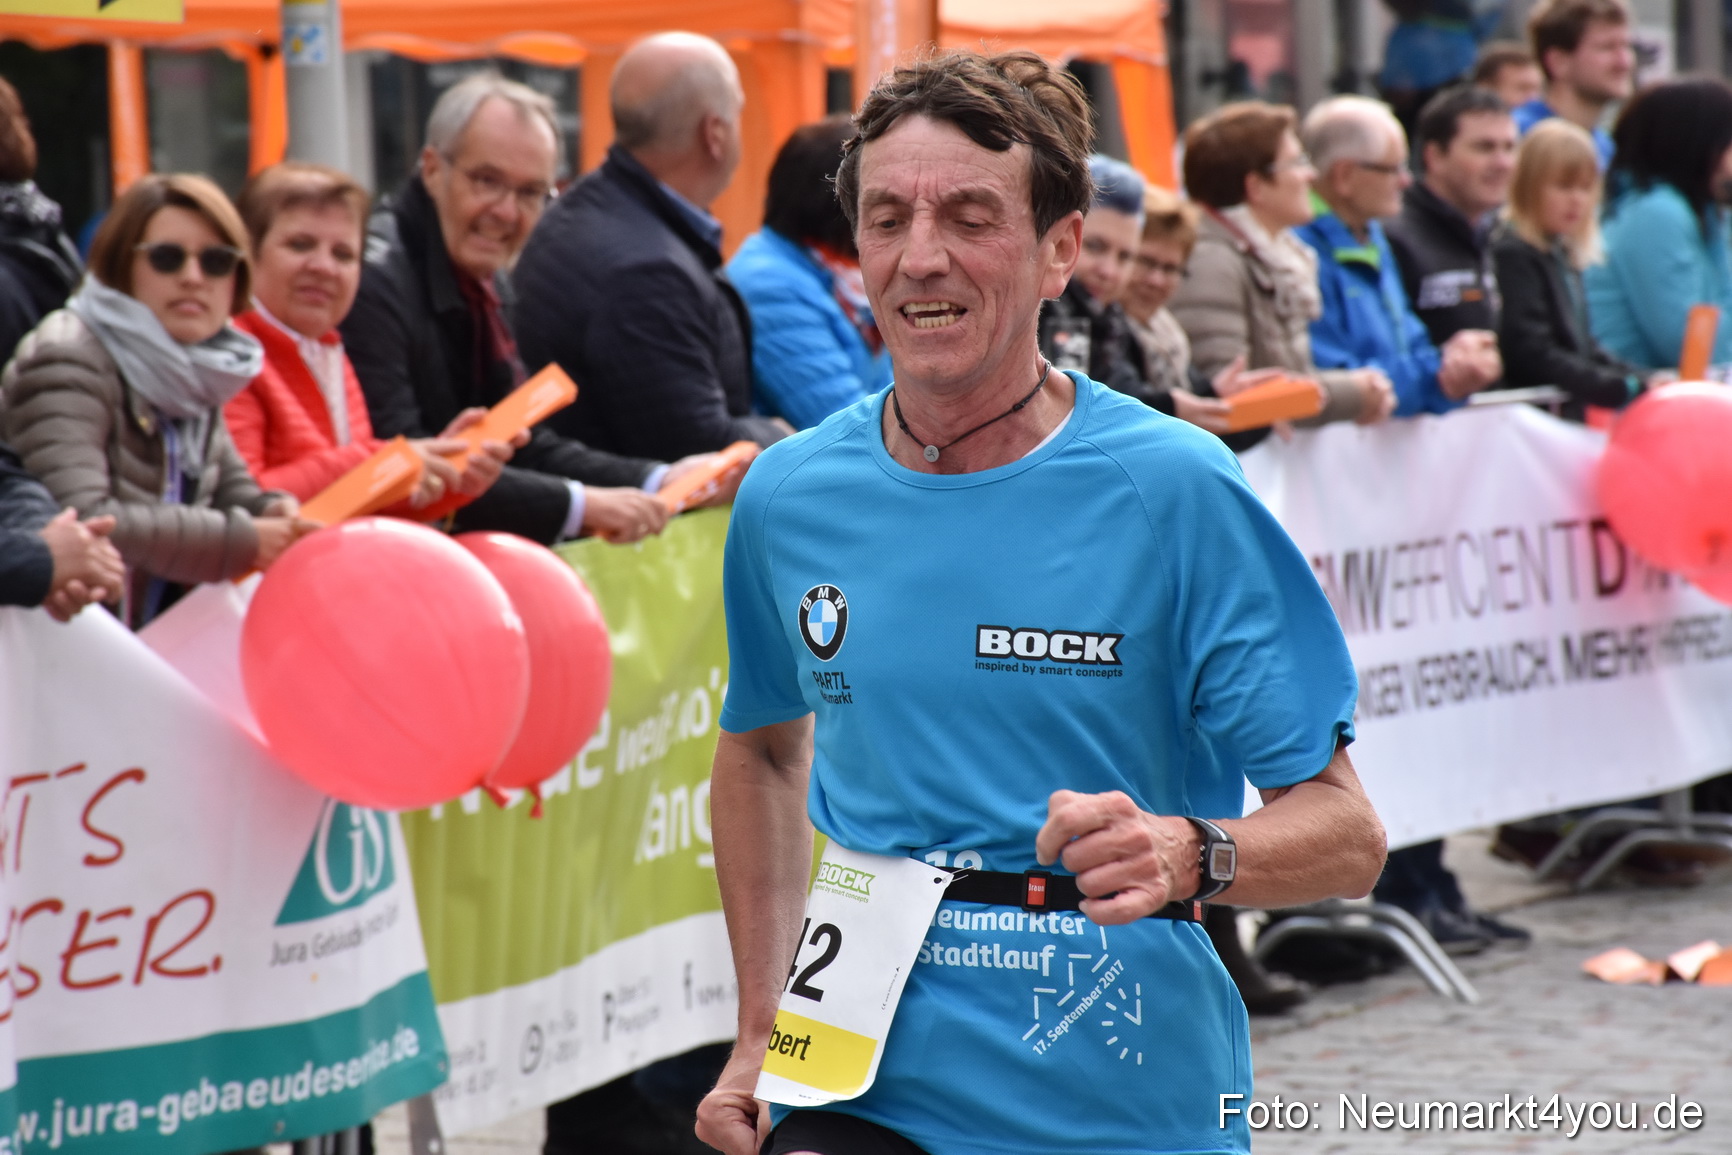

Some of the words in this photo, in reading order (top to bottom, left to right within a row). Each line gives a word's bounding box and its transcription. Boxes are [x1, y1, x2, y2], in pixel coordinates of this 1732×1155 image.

[802, 587, 845, 611] BMW
[977, 627, 1120, 663] BOCK
[812, 671, 850, 690] PARTL
[975, 660, 1018, 672] inspired
[1022, 664, 1035, 675] by
[1039, 667, 1072, 676] smart
[1075, 668, 1123, 679] concepts
[818, 862, 875, 895] BOCK
[831, 887, 845, 896] smart
[845, 892, 869, 903] concepts
[918, 940, 1056, 977] Stadtlauf
[1032, 1039, 1051, 1055] 17.
[1047, 985, 1102, 1042] September
[1098, 959, 1124, 989] 2017
